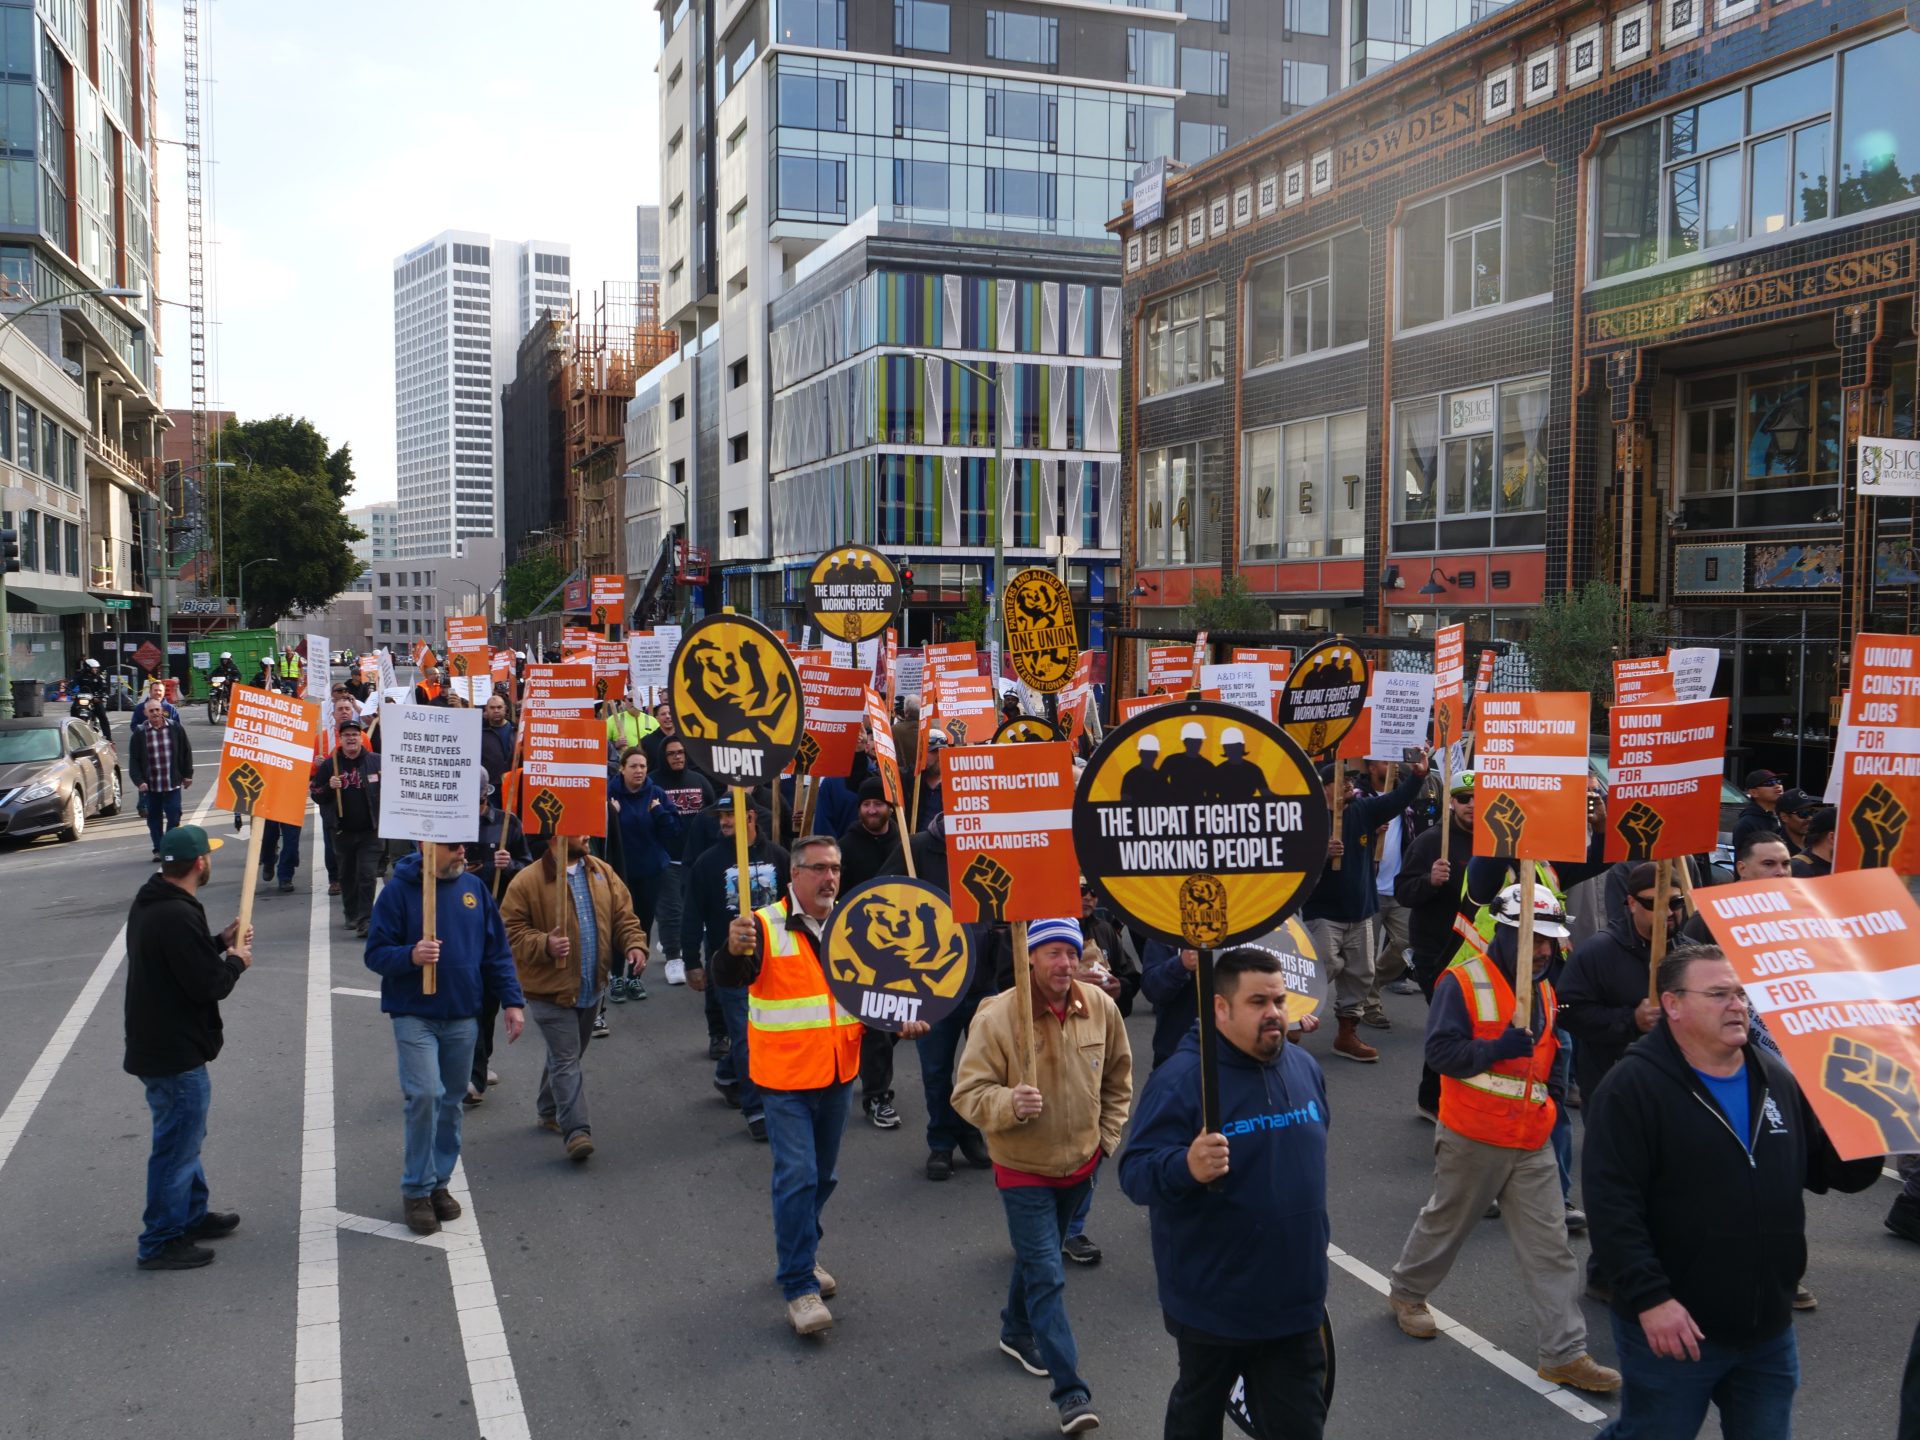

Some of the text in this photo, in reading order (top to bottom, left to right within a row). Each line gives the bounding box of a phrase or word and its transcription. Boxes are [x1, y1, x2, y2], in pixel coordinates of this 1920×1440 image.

[1341, 95, 1471, 173] HOWDEN
[1597, 252, 1898, 339] ROBERT HOWDEN & SONS
[1883, 449, 1920, 470] SPIC
[1016, 572, 1030, 588] AND
[1032, 571, 1059, 589] ALLIED
[814, 585, 892, 597] THE IUPAT FIGHTS FOR
[822, 598, 884, 611] WORKING PEOPLE
[1006, 587, 1018, 630] PAINTERS
[1058, 588, 1072, 623] TRADES
[1012, 627, 1075, 652] ONE UNION
[930, 654, 971, 663] CONSTRUCTION
[1680, 656, 1693, 665] A&D
[1863, 647, 1913, 667] UNION
[530, 669, 553, 677] UNION
[1014, 657, 1068, 691] INTERNATIONAL
[1066, 650, 1077, 679] UNION
[1618, 660, 1660, 671] TRABAJOS DE
[531, 679, 586, 687] CONSTRUCTION
[802, 670, 830, 682] UNION
[1217, 672, 1252, 681] A&D FIRE
[941, 687, 986, 695] CONSTRUCTION
[1290, 684, 1360, 705] THE IUPAT FIGHTS FOR
[1620, 682, 1641, 692] UNION
[239, 690, 303, 716] TRABAJOS DE
[1483, 701, 1521, 715] UNION
[236, 704, 309, 732] CONSTRUCCIÓN
[404, 711, 451, 723] A&D FIRE
[532, 709, 580, 718] OAKLANDERS
[943, 709, 983, 717] OAKLANDERS
[1294, 702, 1351, 721] WORKING PEOPLE
[1858, 702, 1898, 722] JOBS
[530, 723, 559, 734] UNION
[1483, 720, 1576, 734] CONSTRUCTION
[1619, 714, 1662, 729] UNION
[234, 718, 294, 742] DE LA UNIÓN
[403, 732, 458, 743] DOES NOT PAY
[1619, 726, 1715, 747] CONSTRUCTION
[232, 731, 259, 746] PARA
[530, 737, 599, 749] CONSTRUCTION
[1483, 739, 1515, 752] JOBS
[1856, 730, 1885, 749] FOR
[400, 744, 461, 755] ITS EMPLOYEES
[530, 750, 554, 760] JOBS
[229, 746, 294, 771] OAKLANDERS
[390, 754, 471, 767] THE AREA STANDARD
[711, 745, 764, 777] IUPAT
[949, 755, 994, 771] UNION
[1483, 758, 1506, 770] FOR
[1618, 751, 1653, 765] JOBS
[399, 767, 450, 778] ESTABLISHED
[531, 764, 547, 773] FOR
[1853, 756, 1920, 776] OAKLAN
[530, 777, 590, 788] OAKLANDERS
[952, 772, 1059, 791] CONSTRUCTION
[1482, 775, 1562, 790] OAKLANDERS
[1618, 769, 1642, 782] FOR
[400, 779, 457, 790] THIS AREA FOR
[1616, 779, 1699, 799] OAKLANDERS
[400, 791, 459, 802] SIMILAR WORK
[953, 796, 990, 811] JOBS
[955, 817, 981, 831] FOR
[1097, 801, 1303, 837] THE IUPAT FIGHTS FOR
[956, 832, 1049, 851] OAKLANDERS
[1119, 837, 1284, 870] WORKING PEOPLE
[1711, 892, 1792, 919] UNION
[1182, 909, 1227, 922] ONE UNION
[1730, 909, 1908, 947] CONSTRUCTION
[1297, 957, 1316, 978] FOR
[1751, 948, 1815, 976] JOBS
[1764, 979, 1817, 1006] FOR
[860, 990, 923, 1023] IUPAT
[1221, 1108, 1308, 1137] carhartt
